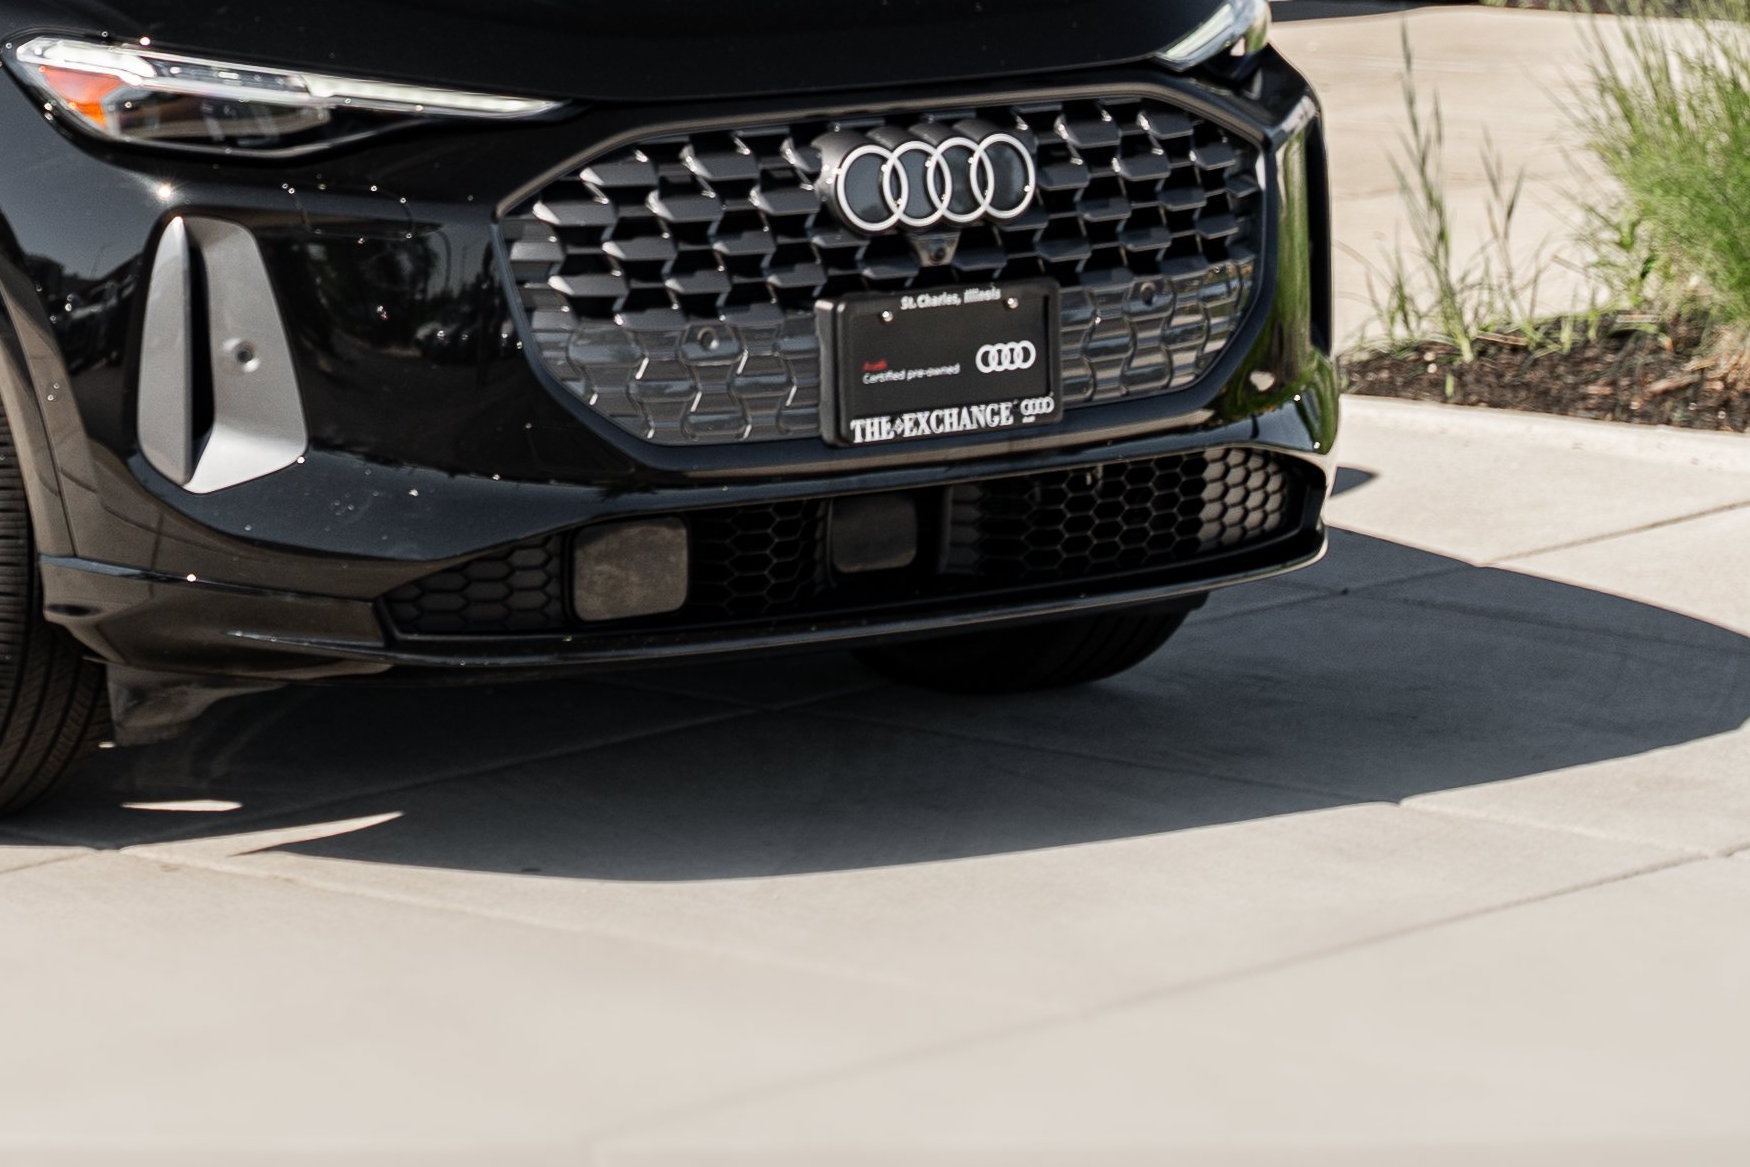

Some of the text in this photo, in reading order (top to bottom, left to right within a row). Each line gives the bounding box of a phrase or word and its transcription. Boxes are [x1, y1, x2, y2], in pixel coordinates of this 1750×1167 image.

[900, 295, 917, 310] St.
[963, 286, 1001, 303] Illinois
[862, 363, 960, 384] Certified pre-owned
[850, 415, 896, 444] THE
[902, 401, 1014, 438] EXCHANGE
